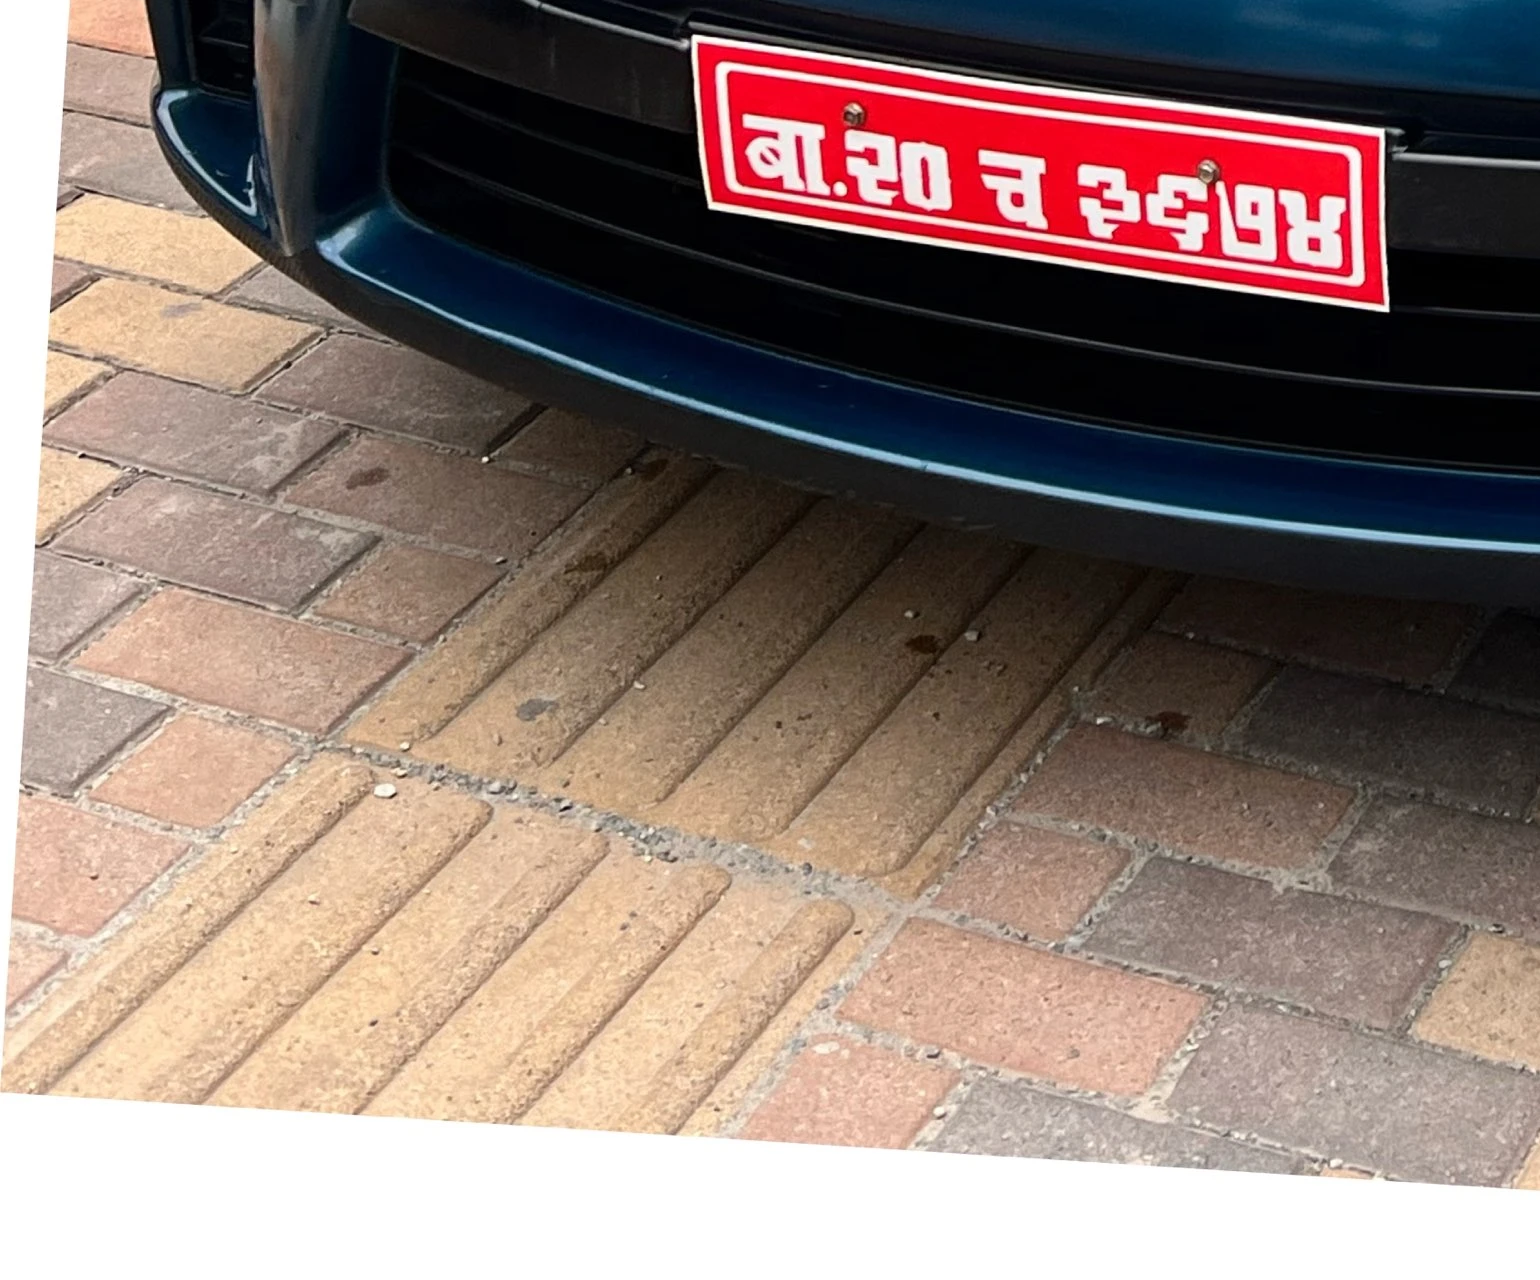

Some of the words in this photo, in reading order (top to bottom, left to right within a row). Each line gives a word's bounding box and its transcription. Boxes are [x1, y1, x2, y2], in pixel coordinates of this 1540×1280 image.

[741, 112, 953, 211] बा.२०
[979, 151, 1048, 230] च
[1077, 163, 1347, 270] ३६७४
